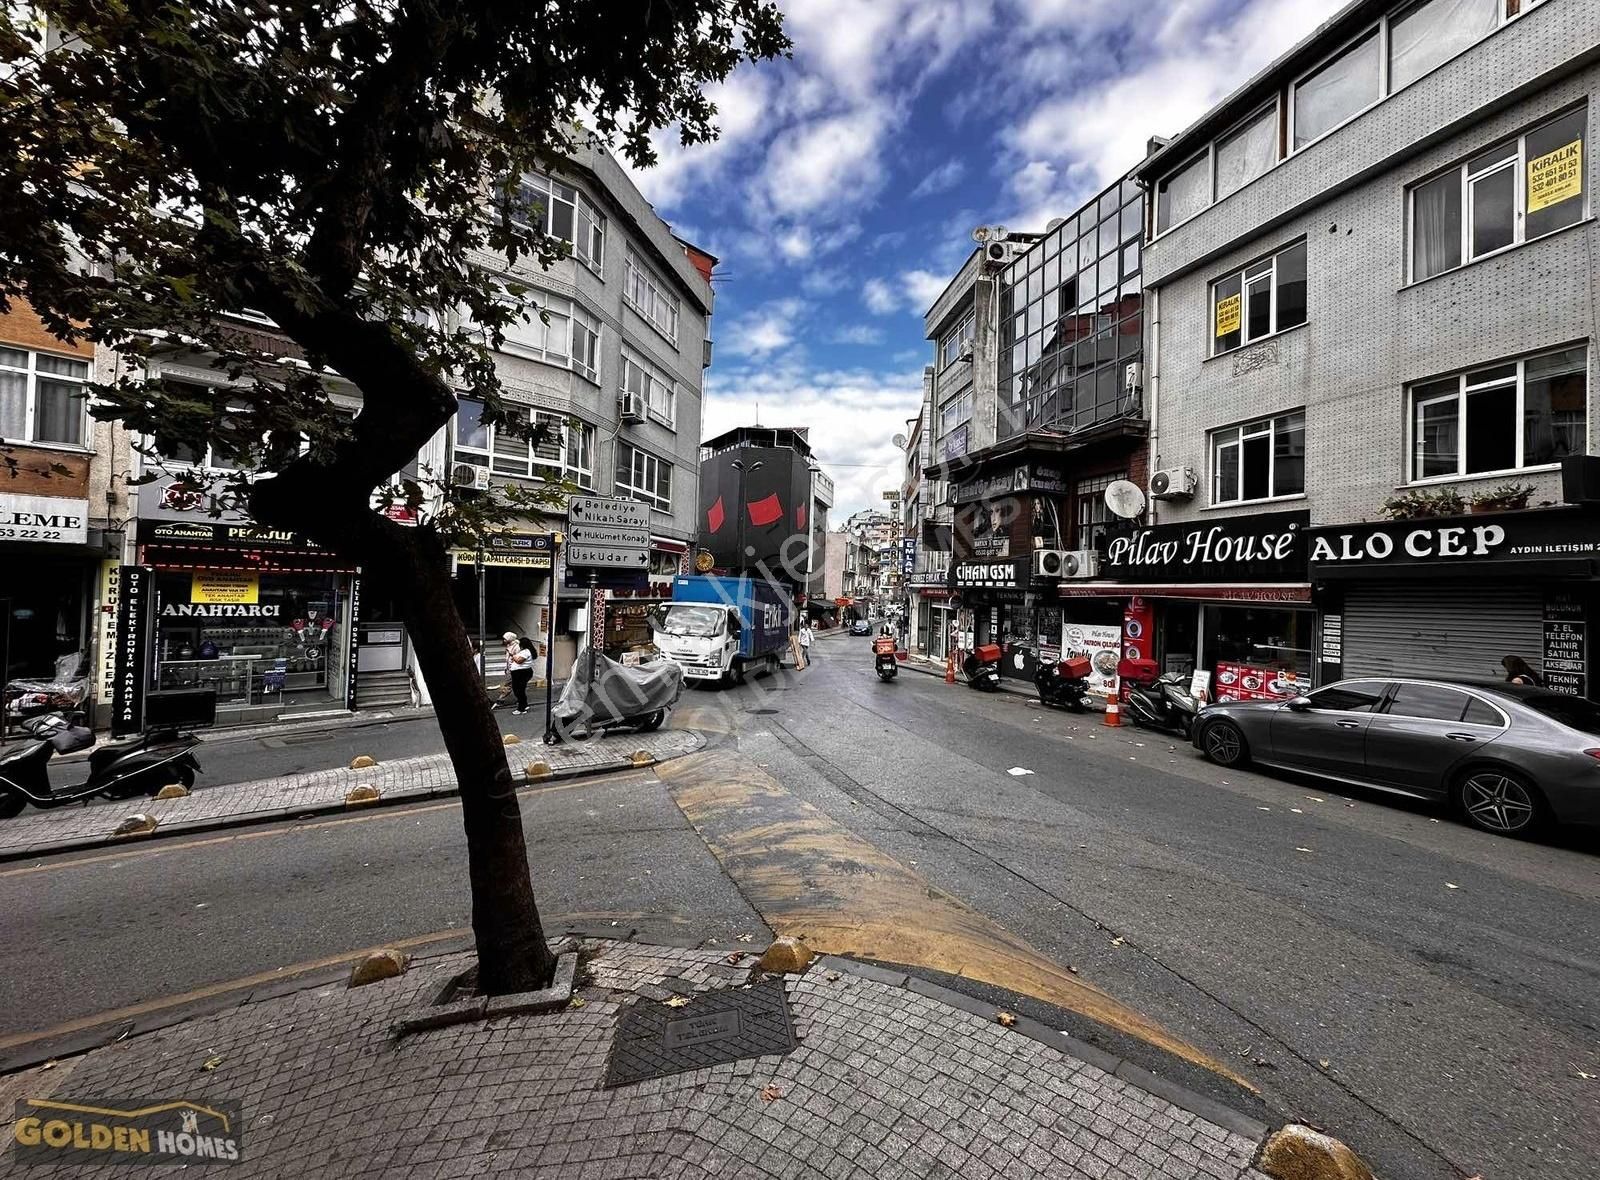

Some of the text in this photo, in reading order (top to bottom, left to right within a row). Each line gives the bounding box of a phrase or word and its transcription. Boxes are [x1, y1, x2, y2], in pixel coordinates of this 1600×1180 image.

[585, 500, 635, 513] Belediye
[584, 512, 648, 526] Nikah Sarayı
[20, 530, 38, 538] 22
[43, 531, 61, 539] 22
[155, 527, 173, 535] OTO
[173, 528, 214, 538] ANAHTAR
[584, 531, 648, 543] Hükümet Konağı
[890, 501, 899, 567] OTOPARK
[1108, 525, 1293, 566] Pilav House
[1310, 524, 1506, 561] ALO CEP
[1510, 545, 1542, 554] AYDIN
[1545, 542, 1594, 553] İLETİŞİM
[572, 548, 629, 562] Üsküdar
[904, 541, 914, 574] EMLAK
[956, 562, 988, 580] CİHAN
[990, 564, 1015, 580] GSM
[108, 567, 120, 605] KURU
[129, 573, 140, 594] OTO
[161, 604, 280, 618] ANAHTARCI
[1553, 624, 1574, 632] 2. EL
[1083, 639, 1101, 647] PATRON
[1545, 632, 1583, 641] TELEFON
[1549, 641, 1578, 650] ALINIR
[104, 611, 117, 698] TEMİZLEME
[1547, 649, 1580, 659] SATILIR
[1545, 661, 1583, 671] AKSESUAR
[1547, 674, 1579, 684] TEKNİK
[1548, 684, 1578, 695] SERVİS
[123, 672, 135, 721] ANAHTAR
